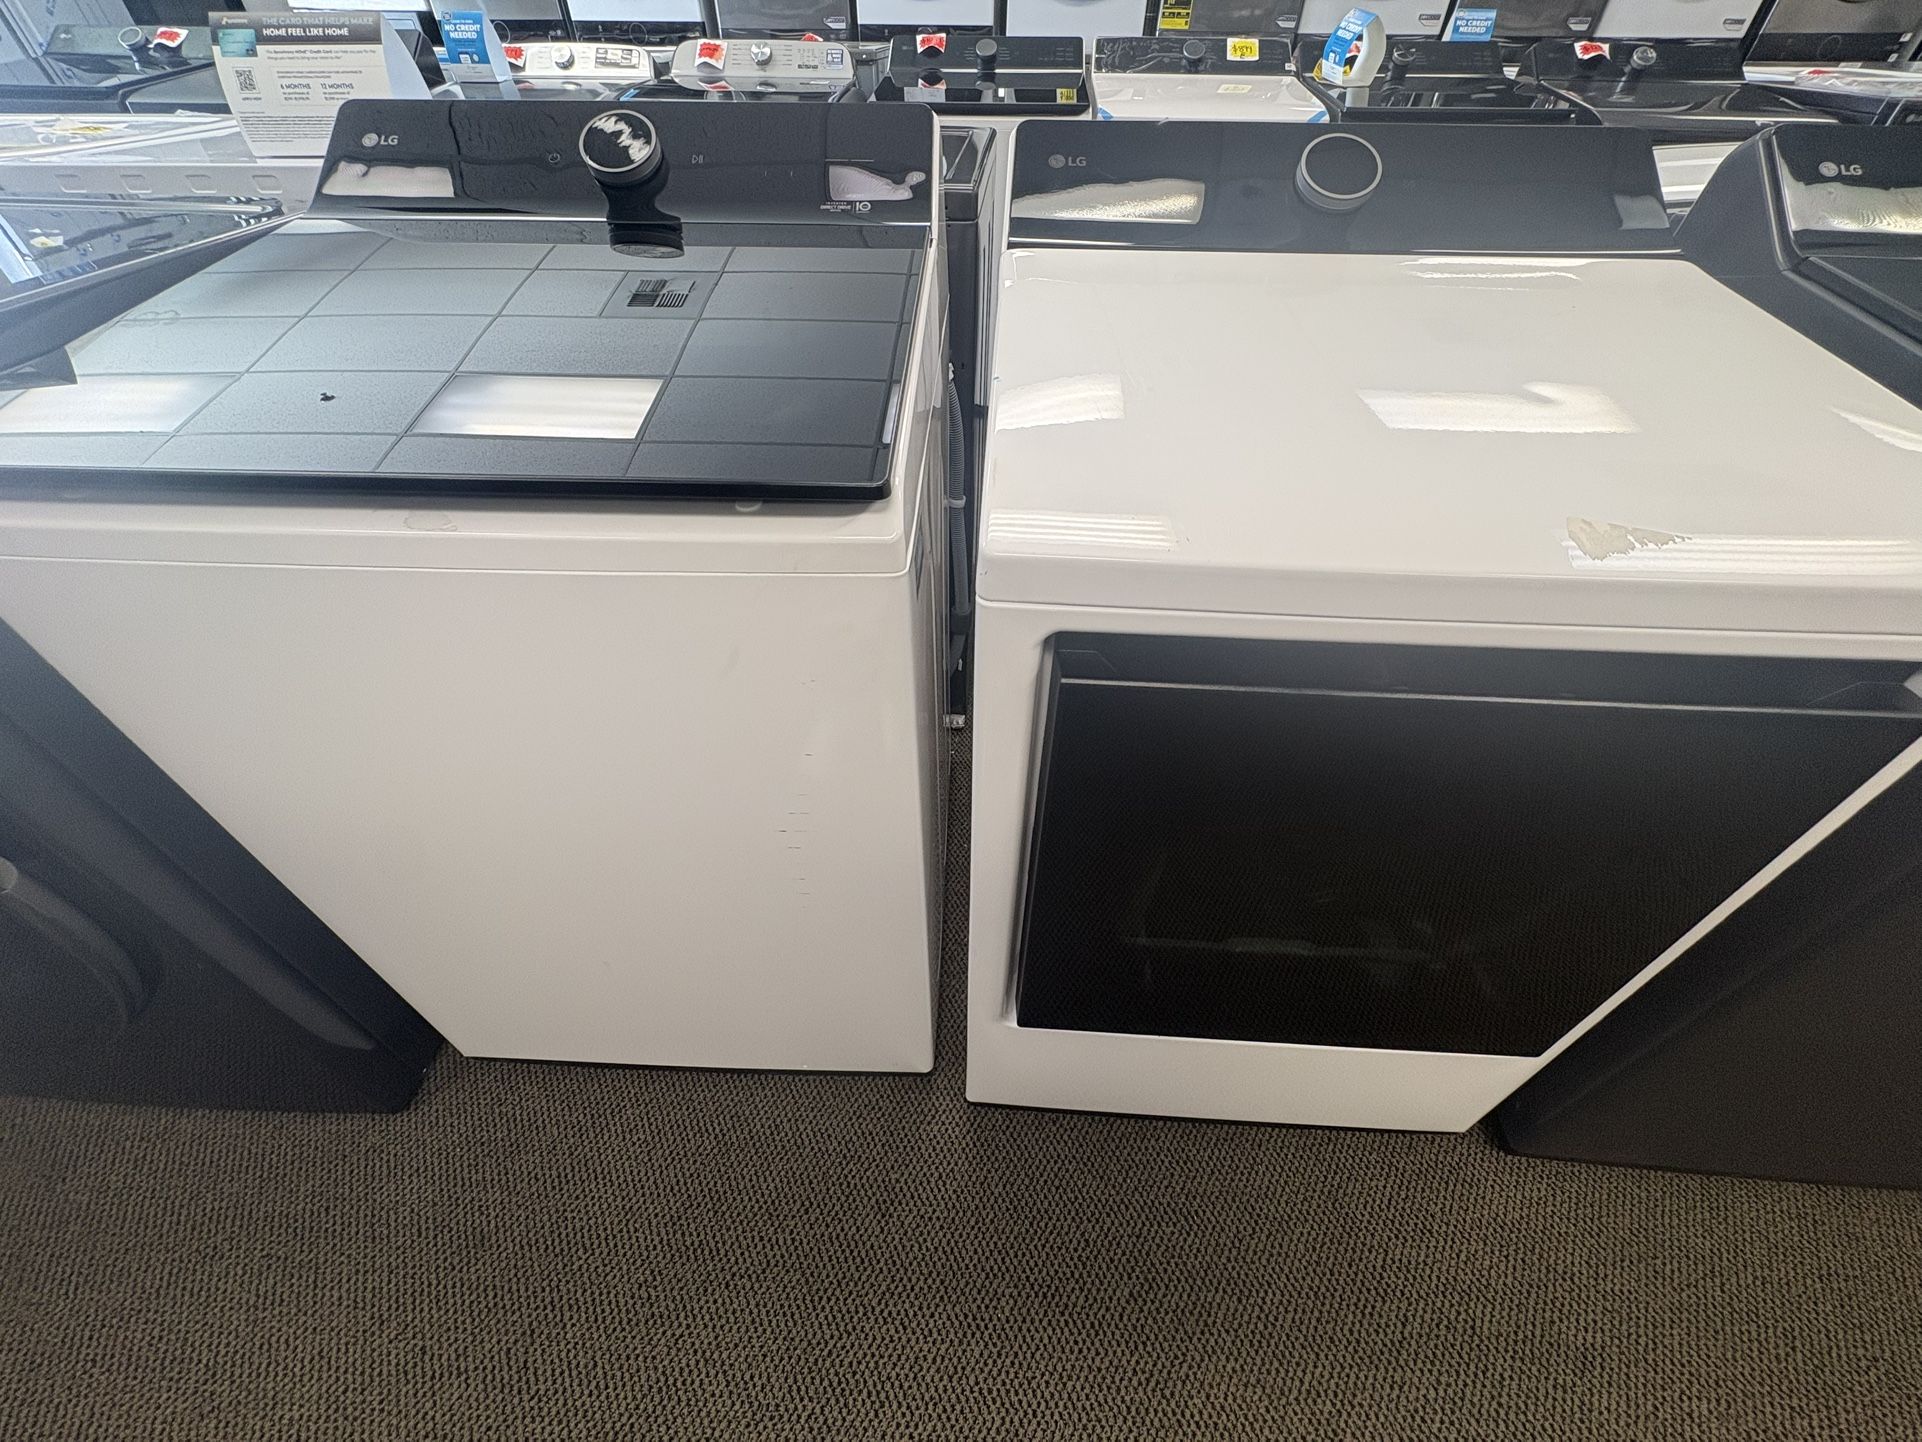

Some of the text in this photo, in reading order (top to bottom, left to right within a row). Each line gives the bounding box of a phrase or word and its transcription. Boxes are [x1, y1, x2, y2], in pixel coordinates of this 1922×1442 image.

[262, 17, 374, 25] THE CARD THAT HELPS MAKE
[262, 28, 349, 36] HOME FEEL LIKE HOME
[380, 135, 398, 145] LG
[1068, 156, 1086, 166] LG
[1840, 164, 1862, 175] LG
